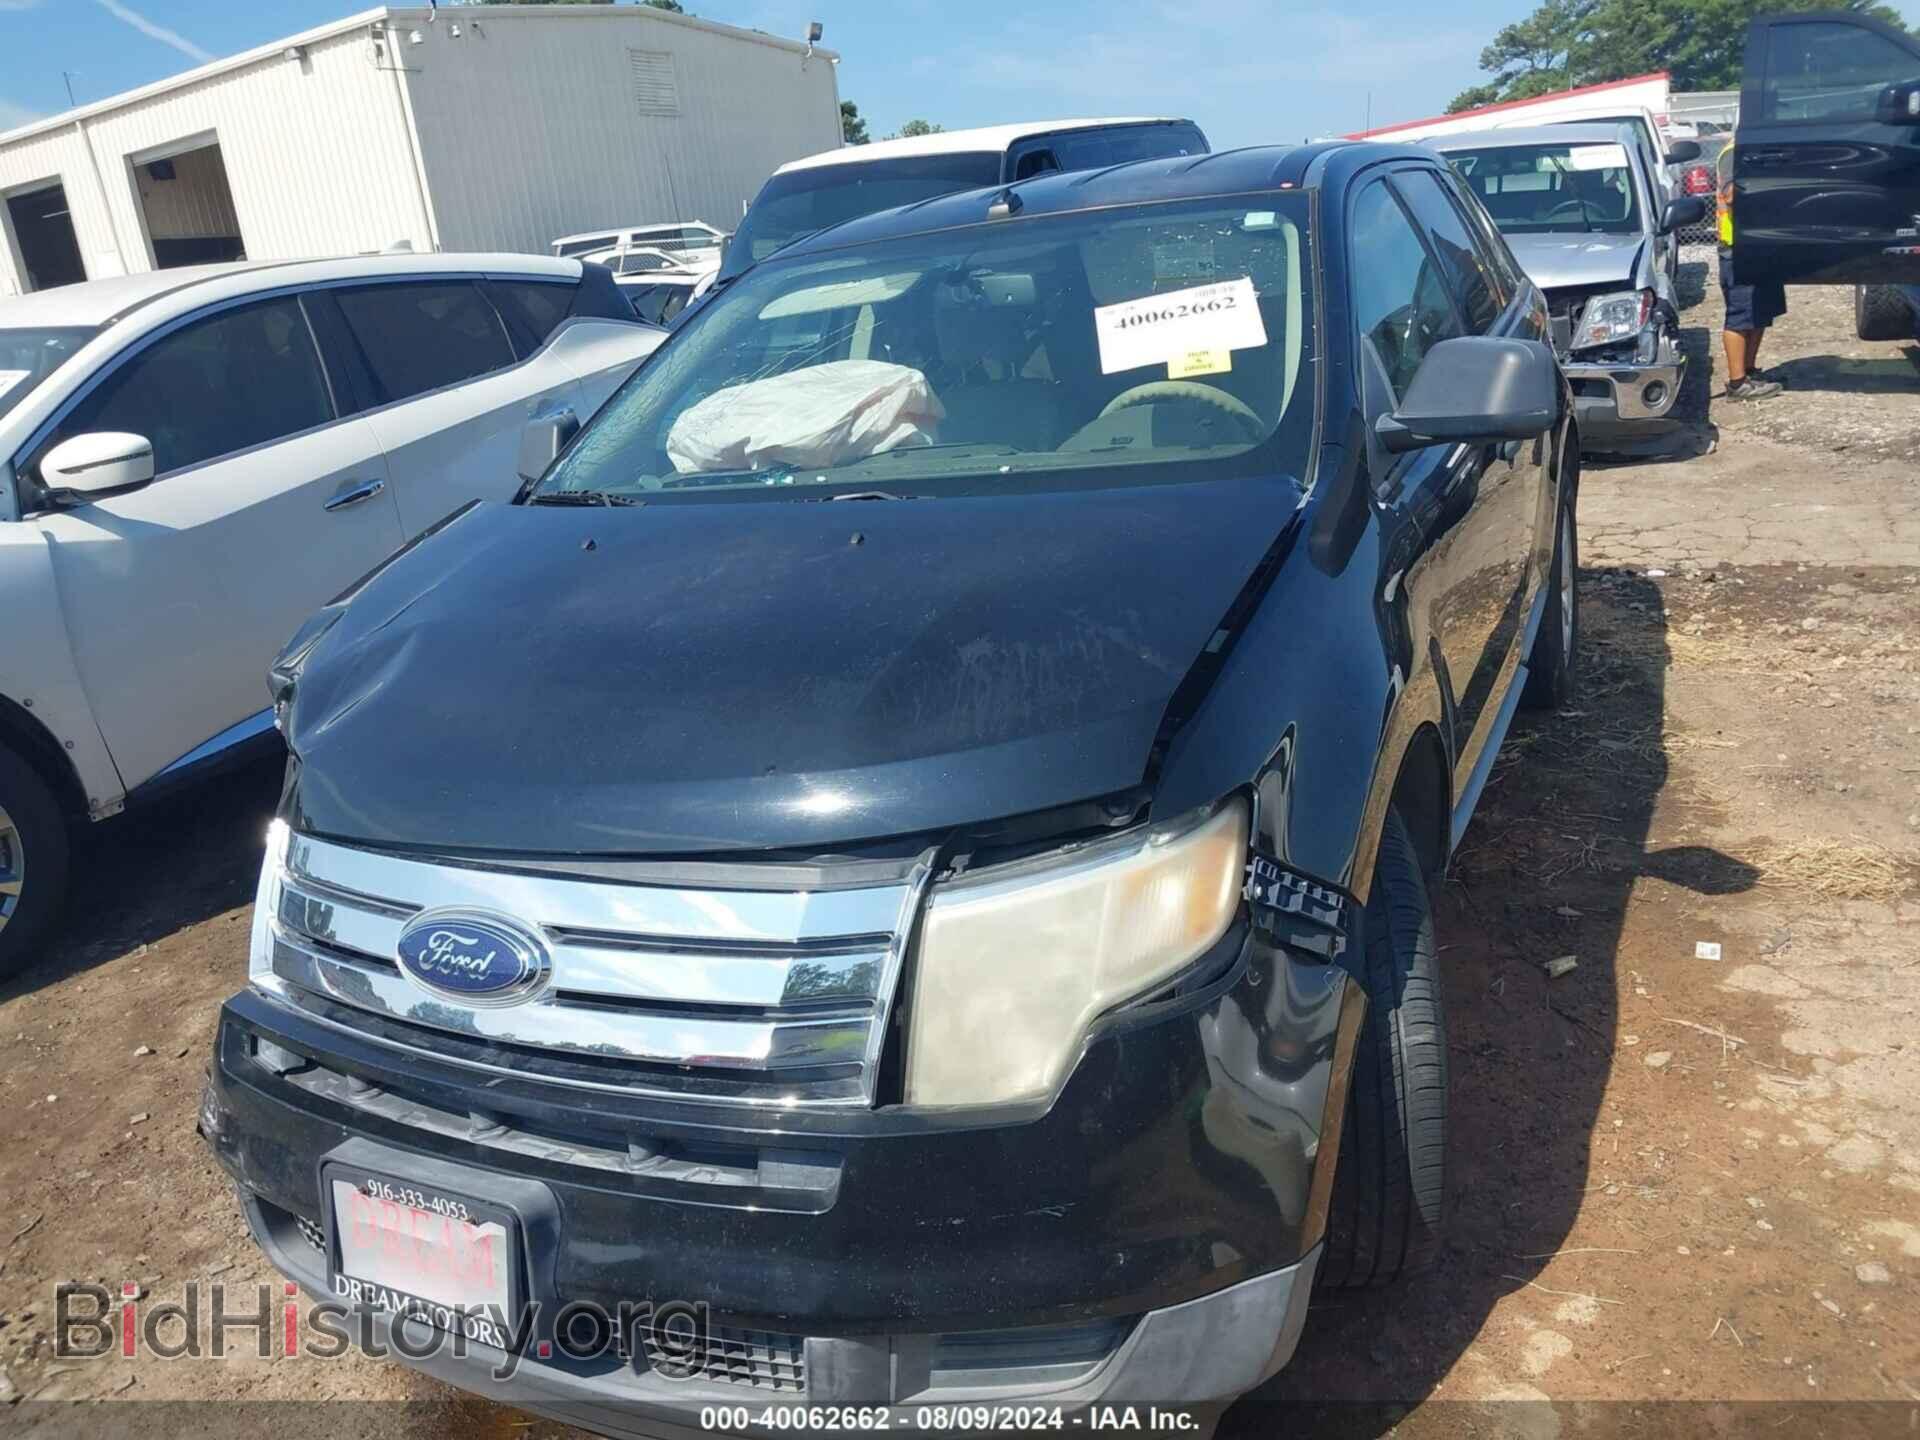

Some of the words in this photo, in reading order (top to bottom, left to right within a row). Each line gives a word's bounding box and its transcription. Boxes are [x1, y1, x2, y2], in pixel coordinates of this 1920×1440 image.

[1114, 297, 1238, 329] 40062662
[418, 930, 497, 981] Ford
[367, 1179, 468, 1221] 916-333-4053
[334, 1274, 410, 1317] DREAM
[414, 1298, 505, 1349] MOTORS
